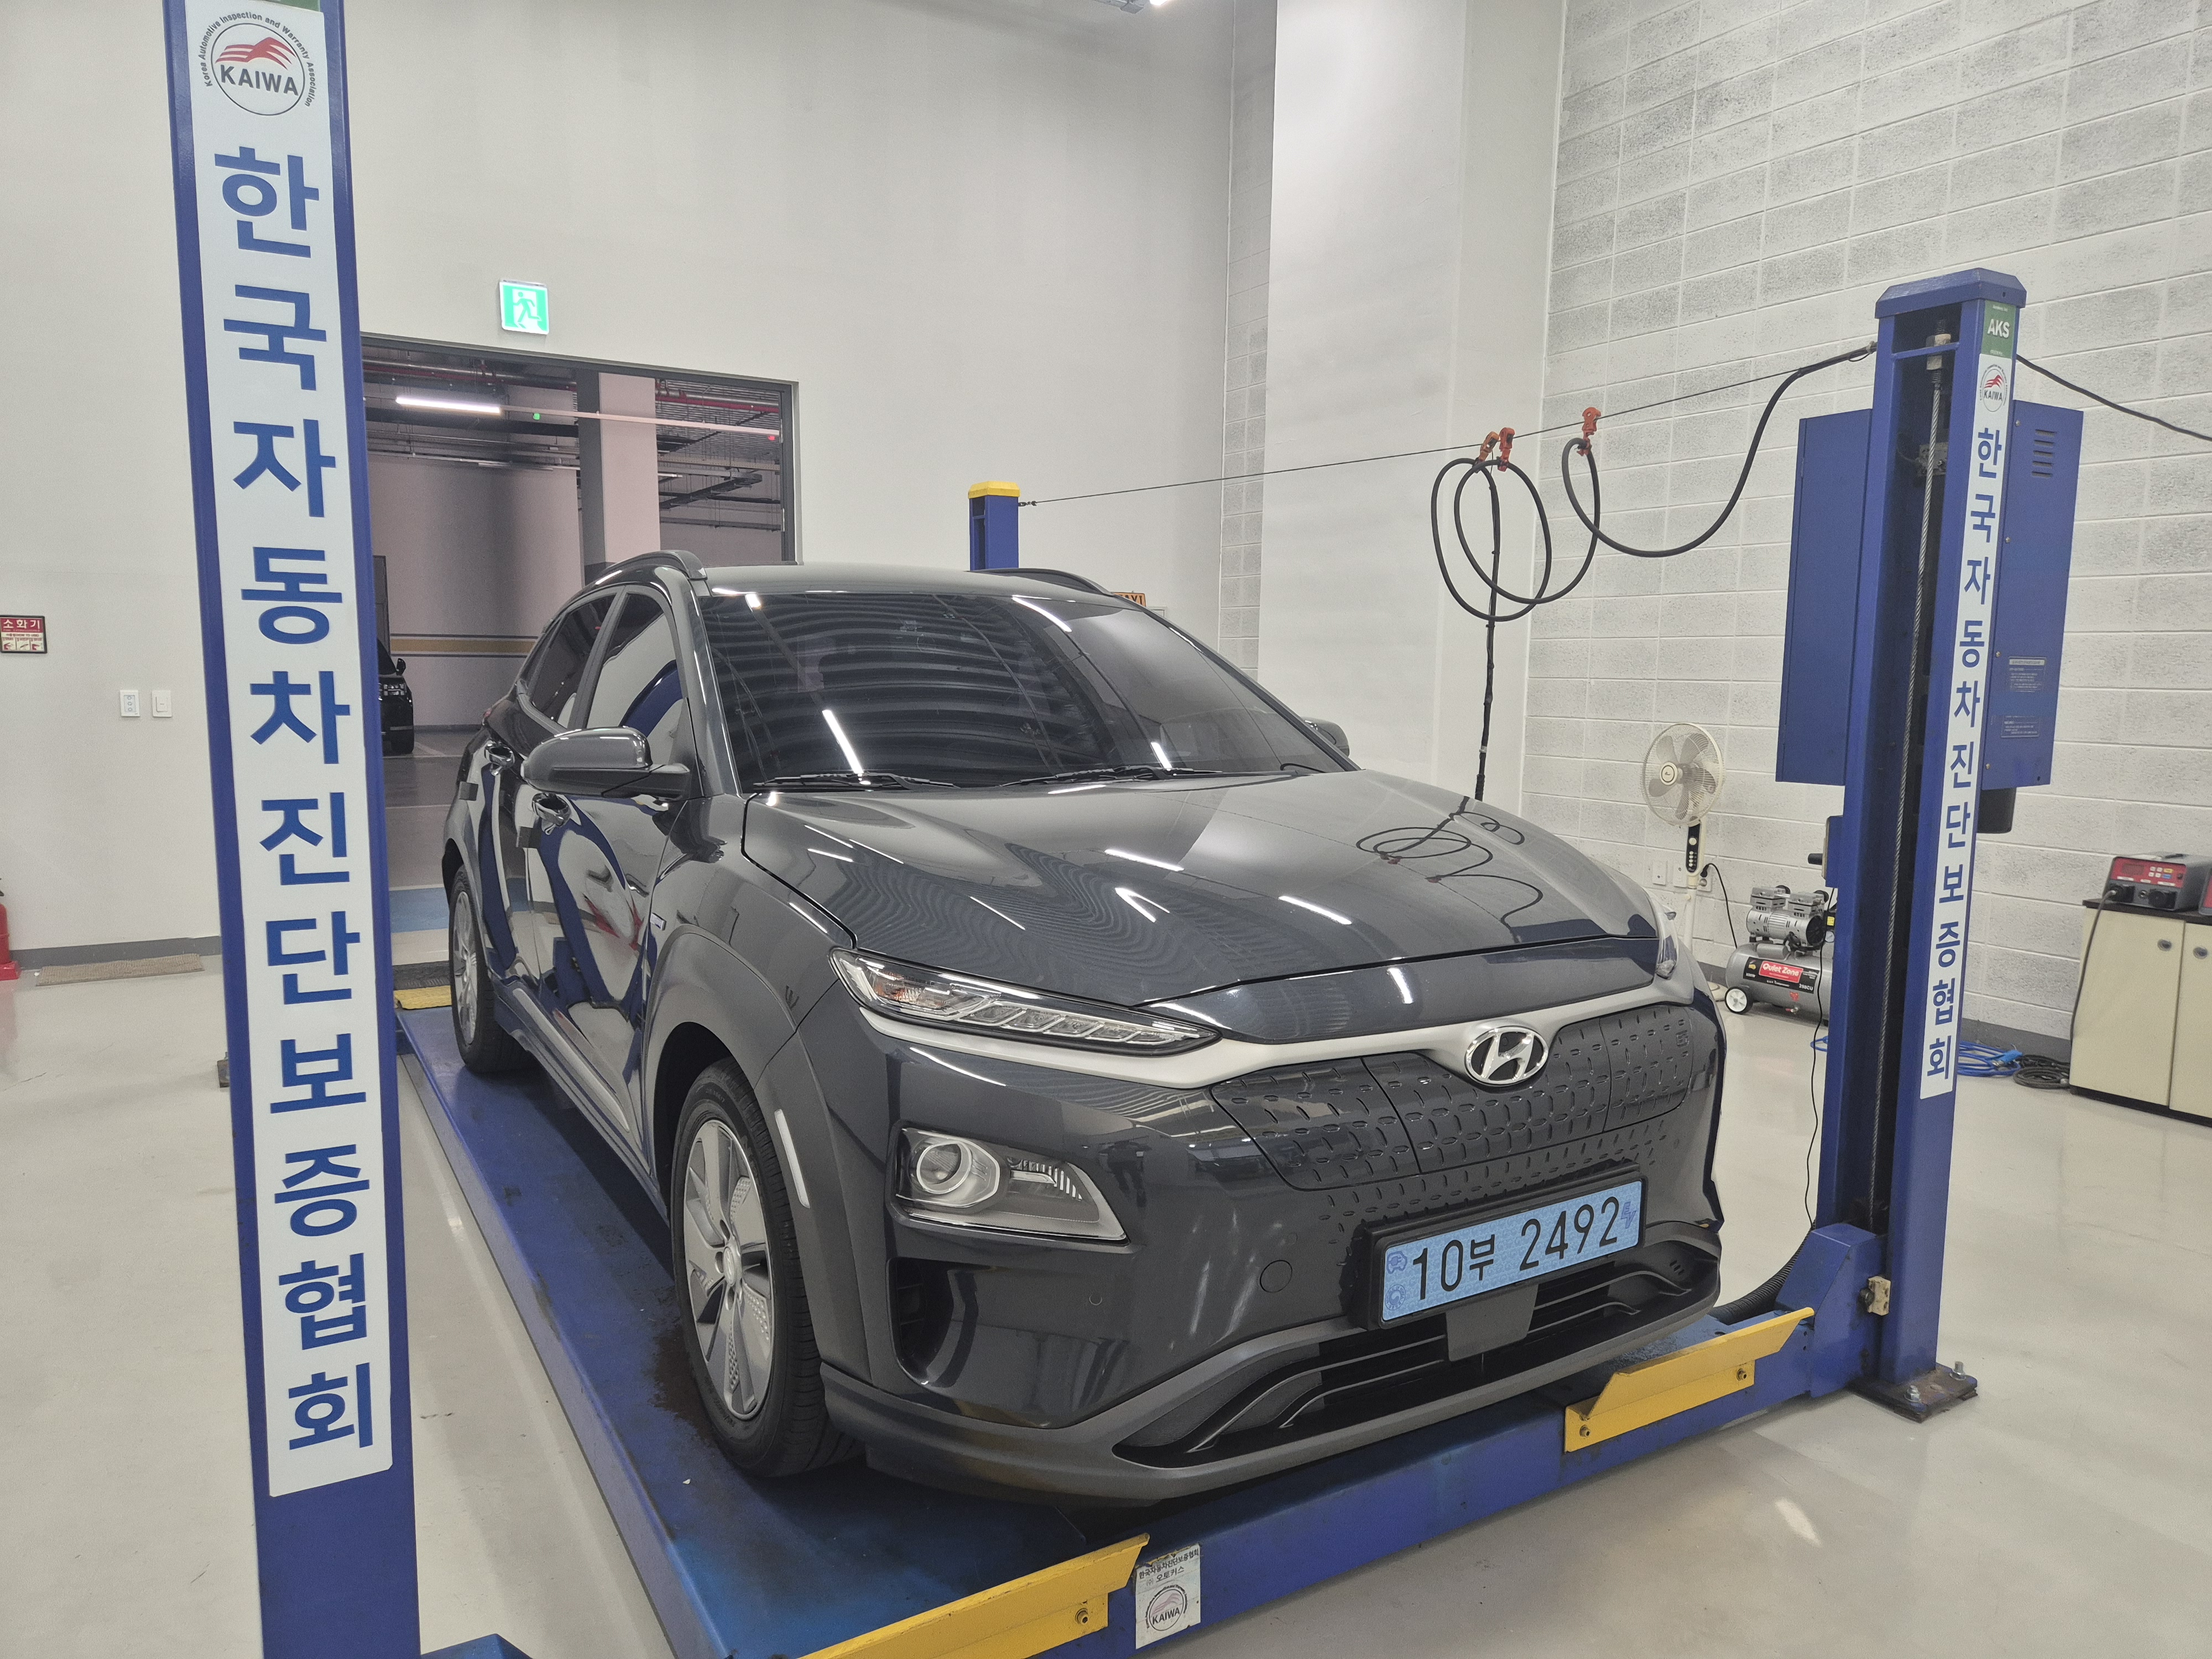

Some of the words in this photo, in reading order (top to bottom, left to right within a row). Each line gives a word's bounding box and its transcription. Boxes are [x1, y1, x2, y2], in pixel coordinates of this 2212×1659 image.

[220, 12, 262, 23] Inspection
[265, 17, 280, 28] and
[198, 21, 221, 60] Automotive
[282, 26, 310, 59] Warranty
[201, 62, 213, 86] Korea
[221, 64, 299, 96] KAIWA
[305, 62, 317, 107] Association
[1987, 319, 2010, 338] AKS
[1984, 390, 2002, 401] KAIWA
[3, 619, 40, 630] 소화기
[1927, 427, 2002, 1079] 한국자동차진단보증협회
[214, 146, 373, 1451] 한국자동차진단보증협회
[1762, 963, 1781, 973] Quiet
[1782, 967, 1799, 977] Zone
[1620, 1201, 1637, 1229] EV
[1412, 1234, 1495, 1300] 10부
[1519, 1197, 1620, 1271] 2492
[1139, 1548, 1199, 1579] 한국자동차진단보증협회
[1156, 1566, 1185, 1582] 오토키스
[1152, 1606, 1181, 1625] KAIWA
